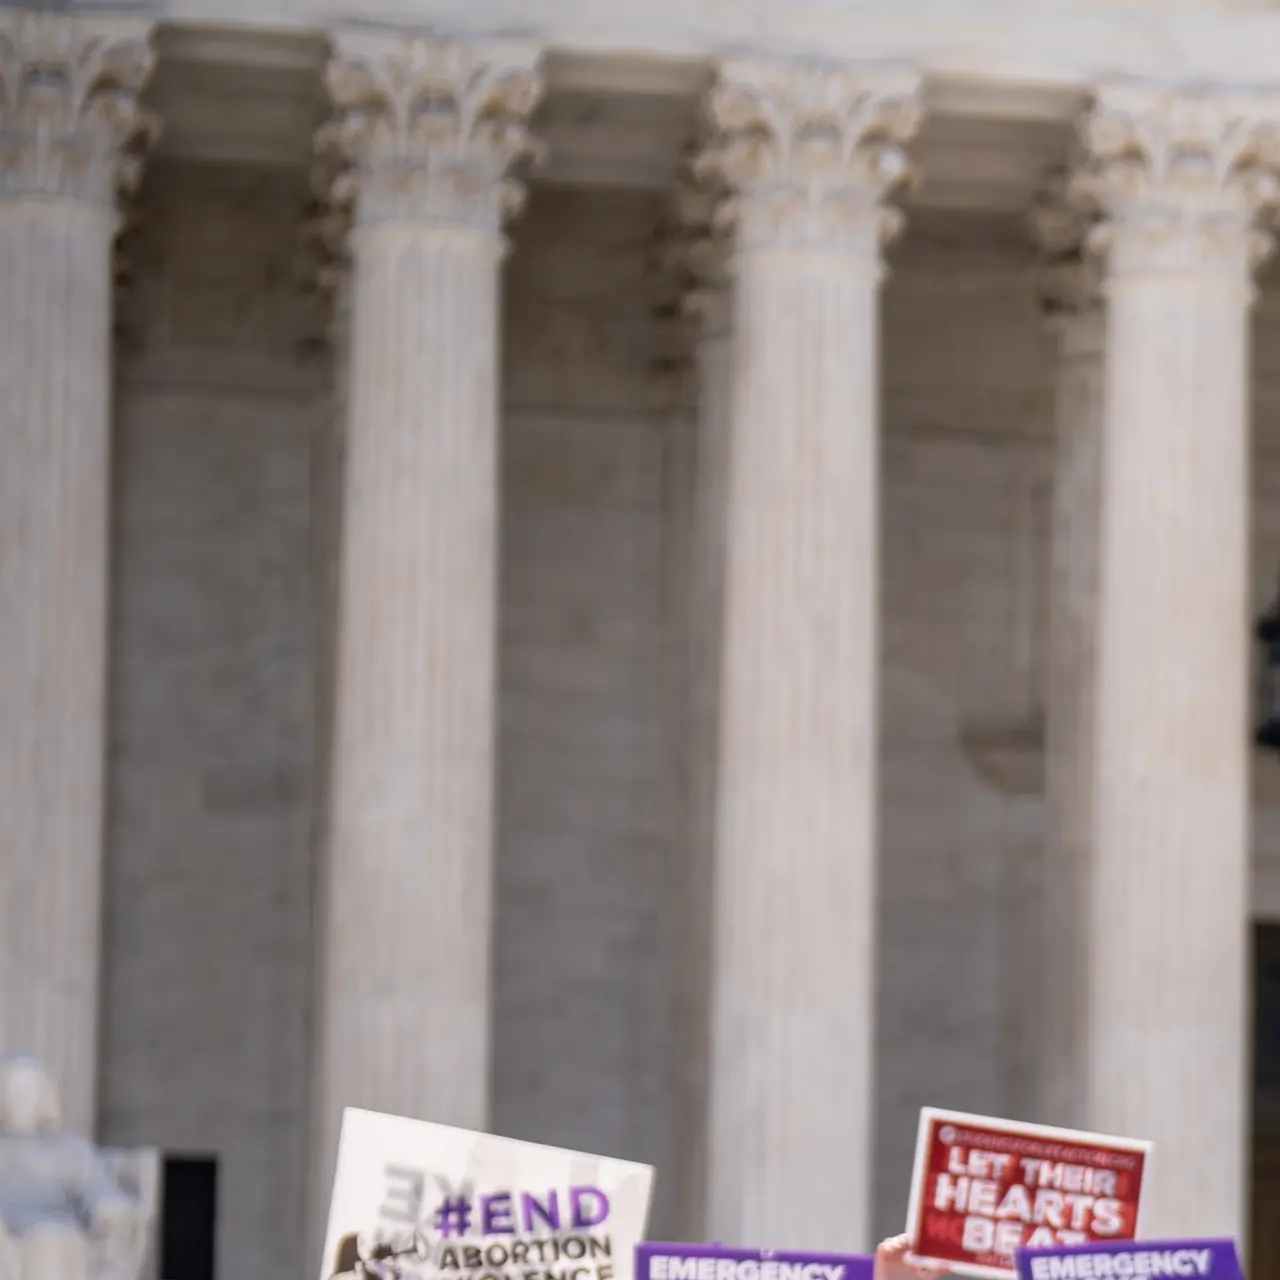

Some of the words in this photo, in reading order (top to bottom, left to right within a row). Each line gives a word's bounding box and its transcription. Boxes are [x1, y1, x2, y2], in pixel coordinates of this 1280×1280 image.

[948, 1146, 1012, 1180] LET
[1020, 1157, 1119, 1197] THEIR
[434, 1185, 610, 1238] #END
[934, 1172, 1126, 1236] HEARTS
[439, 1234, 613, 1270] ABORTION
